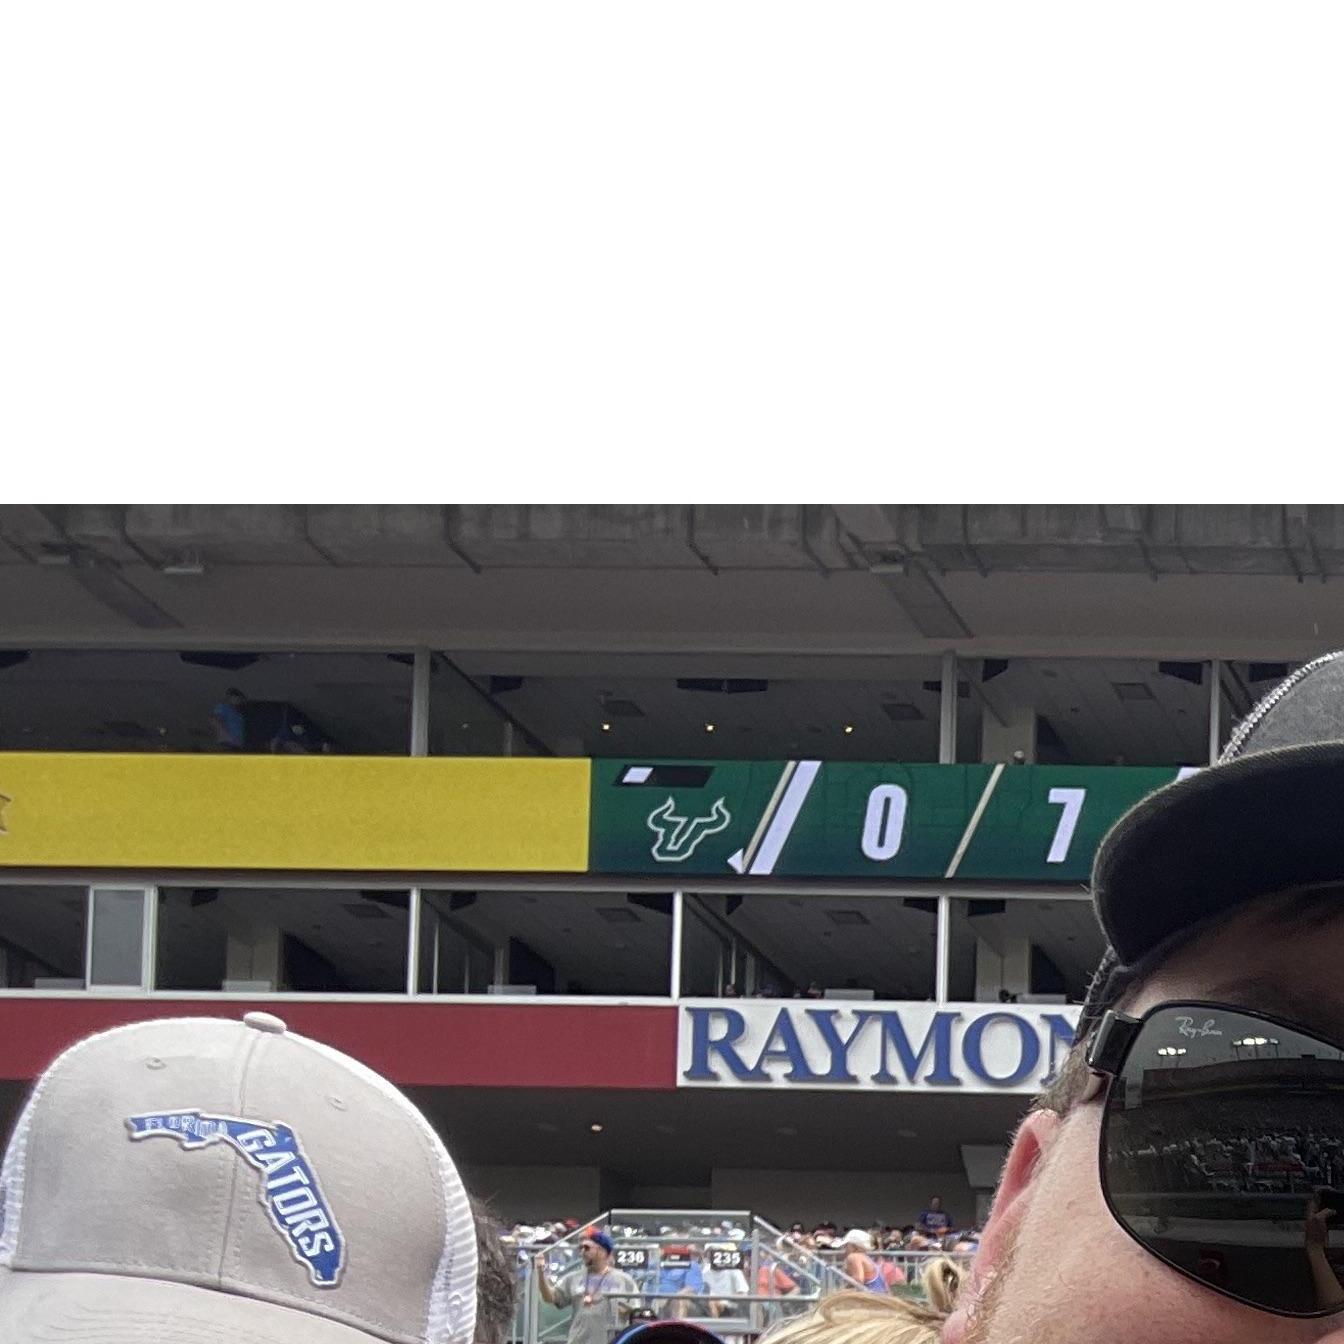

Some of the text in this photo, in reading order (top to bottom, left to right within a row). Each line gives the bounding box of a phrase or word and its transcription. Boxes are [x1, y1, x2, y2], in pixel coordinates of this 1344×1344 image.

[861, 784, 908, 861] 0
[1046, 788, 1086, 862] 7
[236, 1128, 334, 1258] GATORS
[713, 1252, 741, 1264] 235
